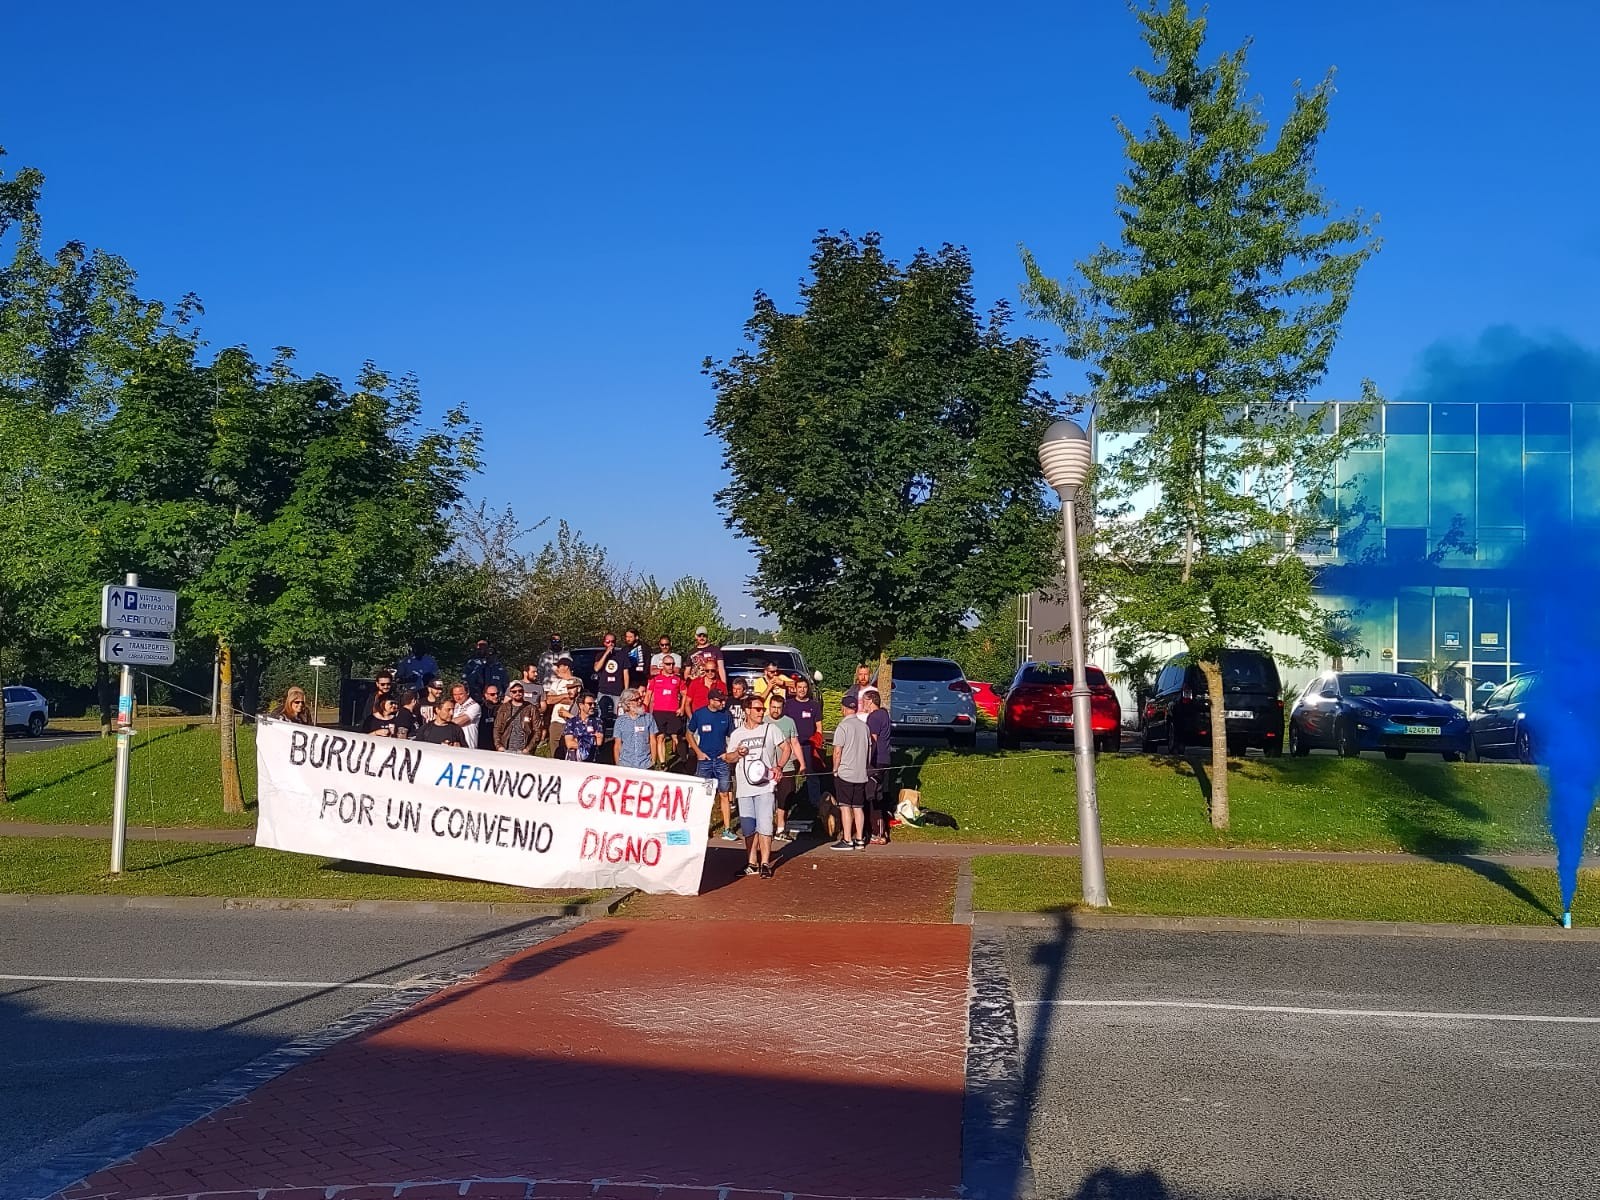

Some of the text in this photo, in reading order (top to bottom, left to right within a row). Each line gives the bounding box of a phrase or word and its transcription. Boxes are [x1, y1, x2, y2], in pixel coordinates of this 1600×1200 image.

[129, 642, 170, 651] TRANSPORTES
[289, 730, 693, 823] BURULAN AERNNOVA GREBAN
[319, 788, 663, 867] POR UN CONVENIO DIGNO
